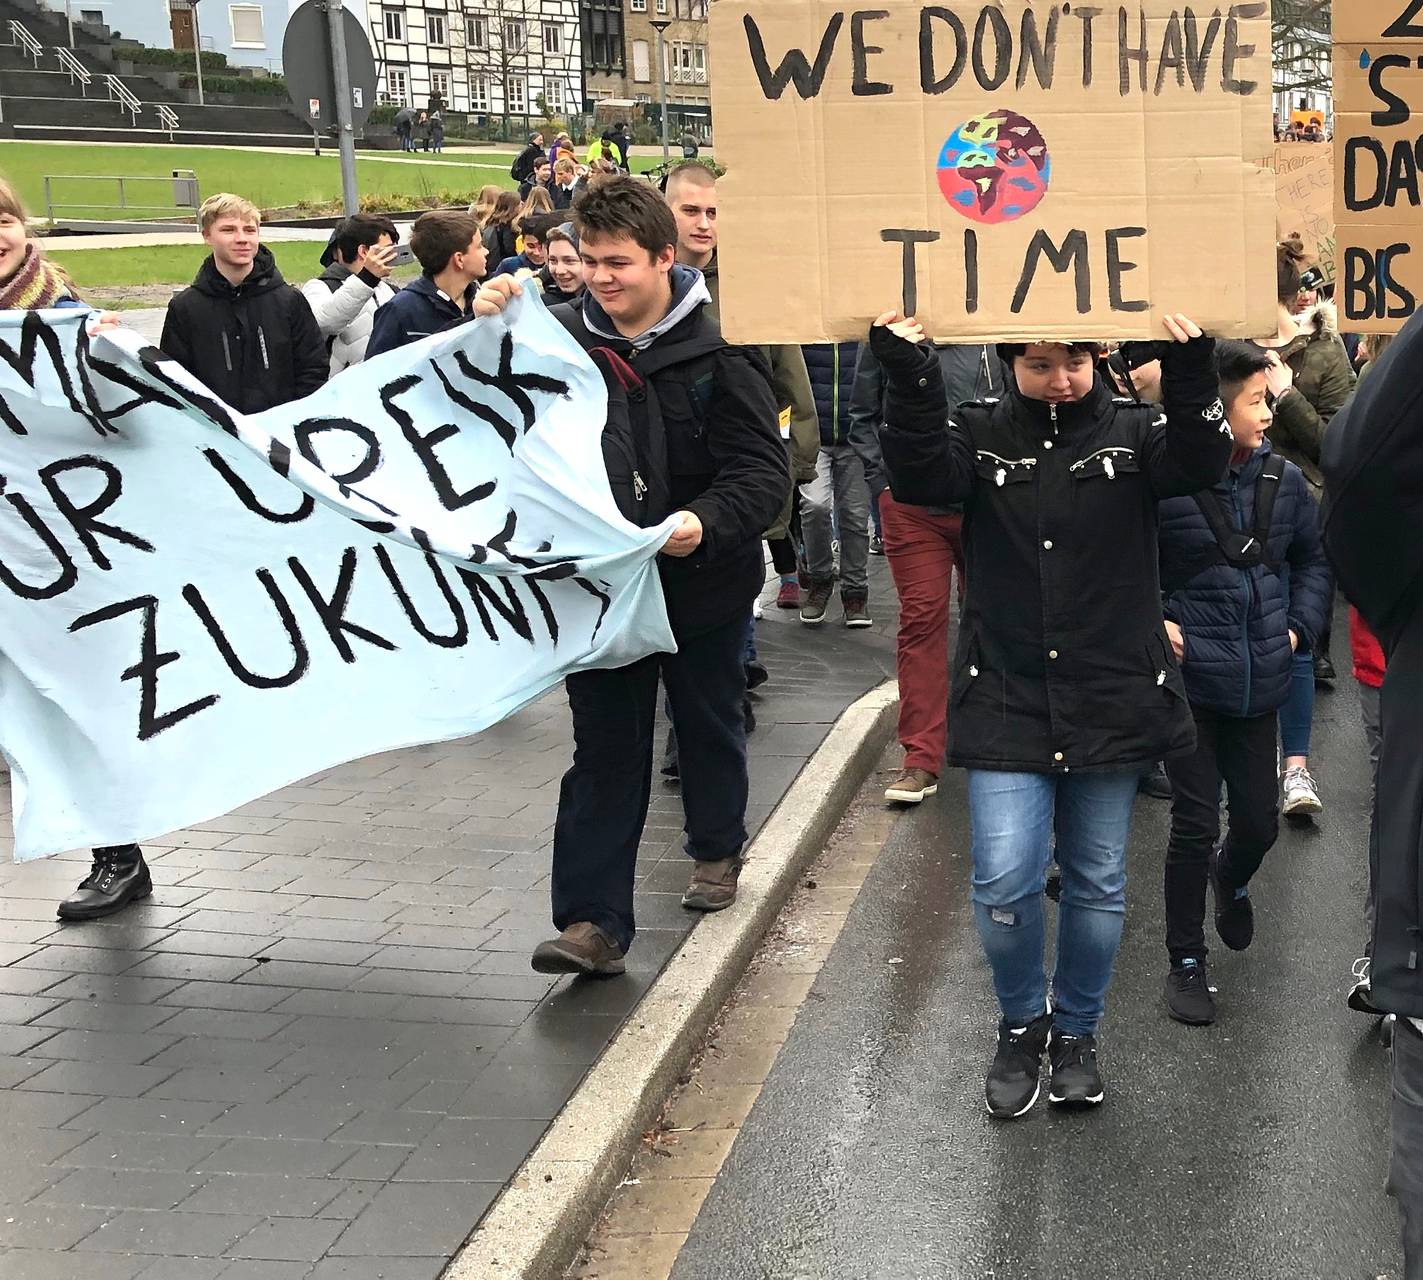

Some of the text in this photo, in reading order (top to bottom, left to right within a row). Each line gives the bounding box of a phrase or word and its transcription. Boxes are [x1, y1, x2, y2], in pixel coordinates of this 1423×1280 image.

[743, 2, 1270, 101] WE DON'T HAVE
[880, 226, 1155, 319] TIME
[1344, 242, 1416, 321] BIS
